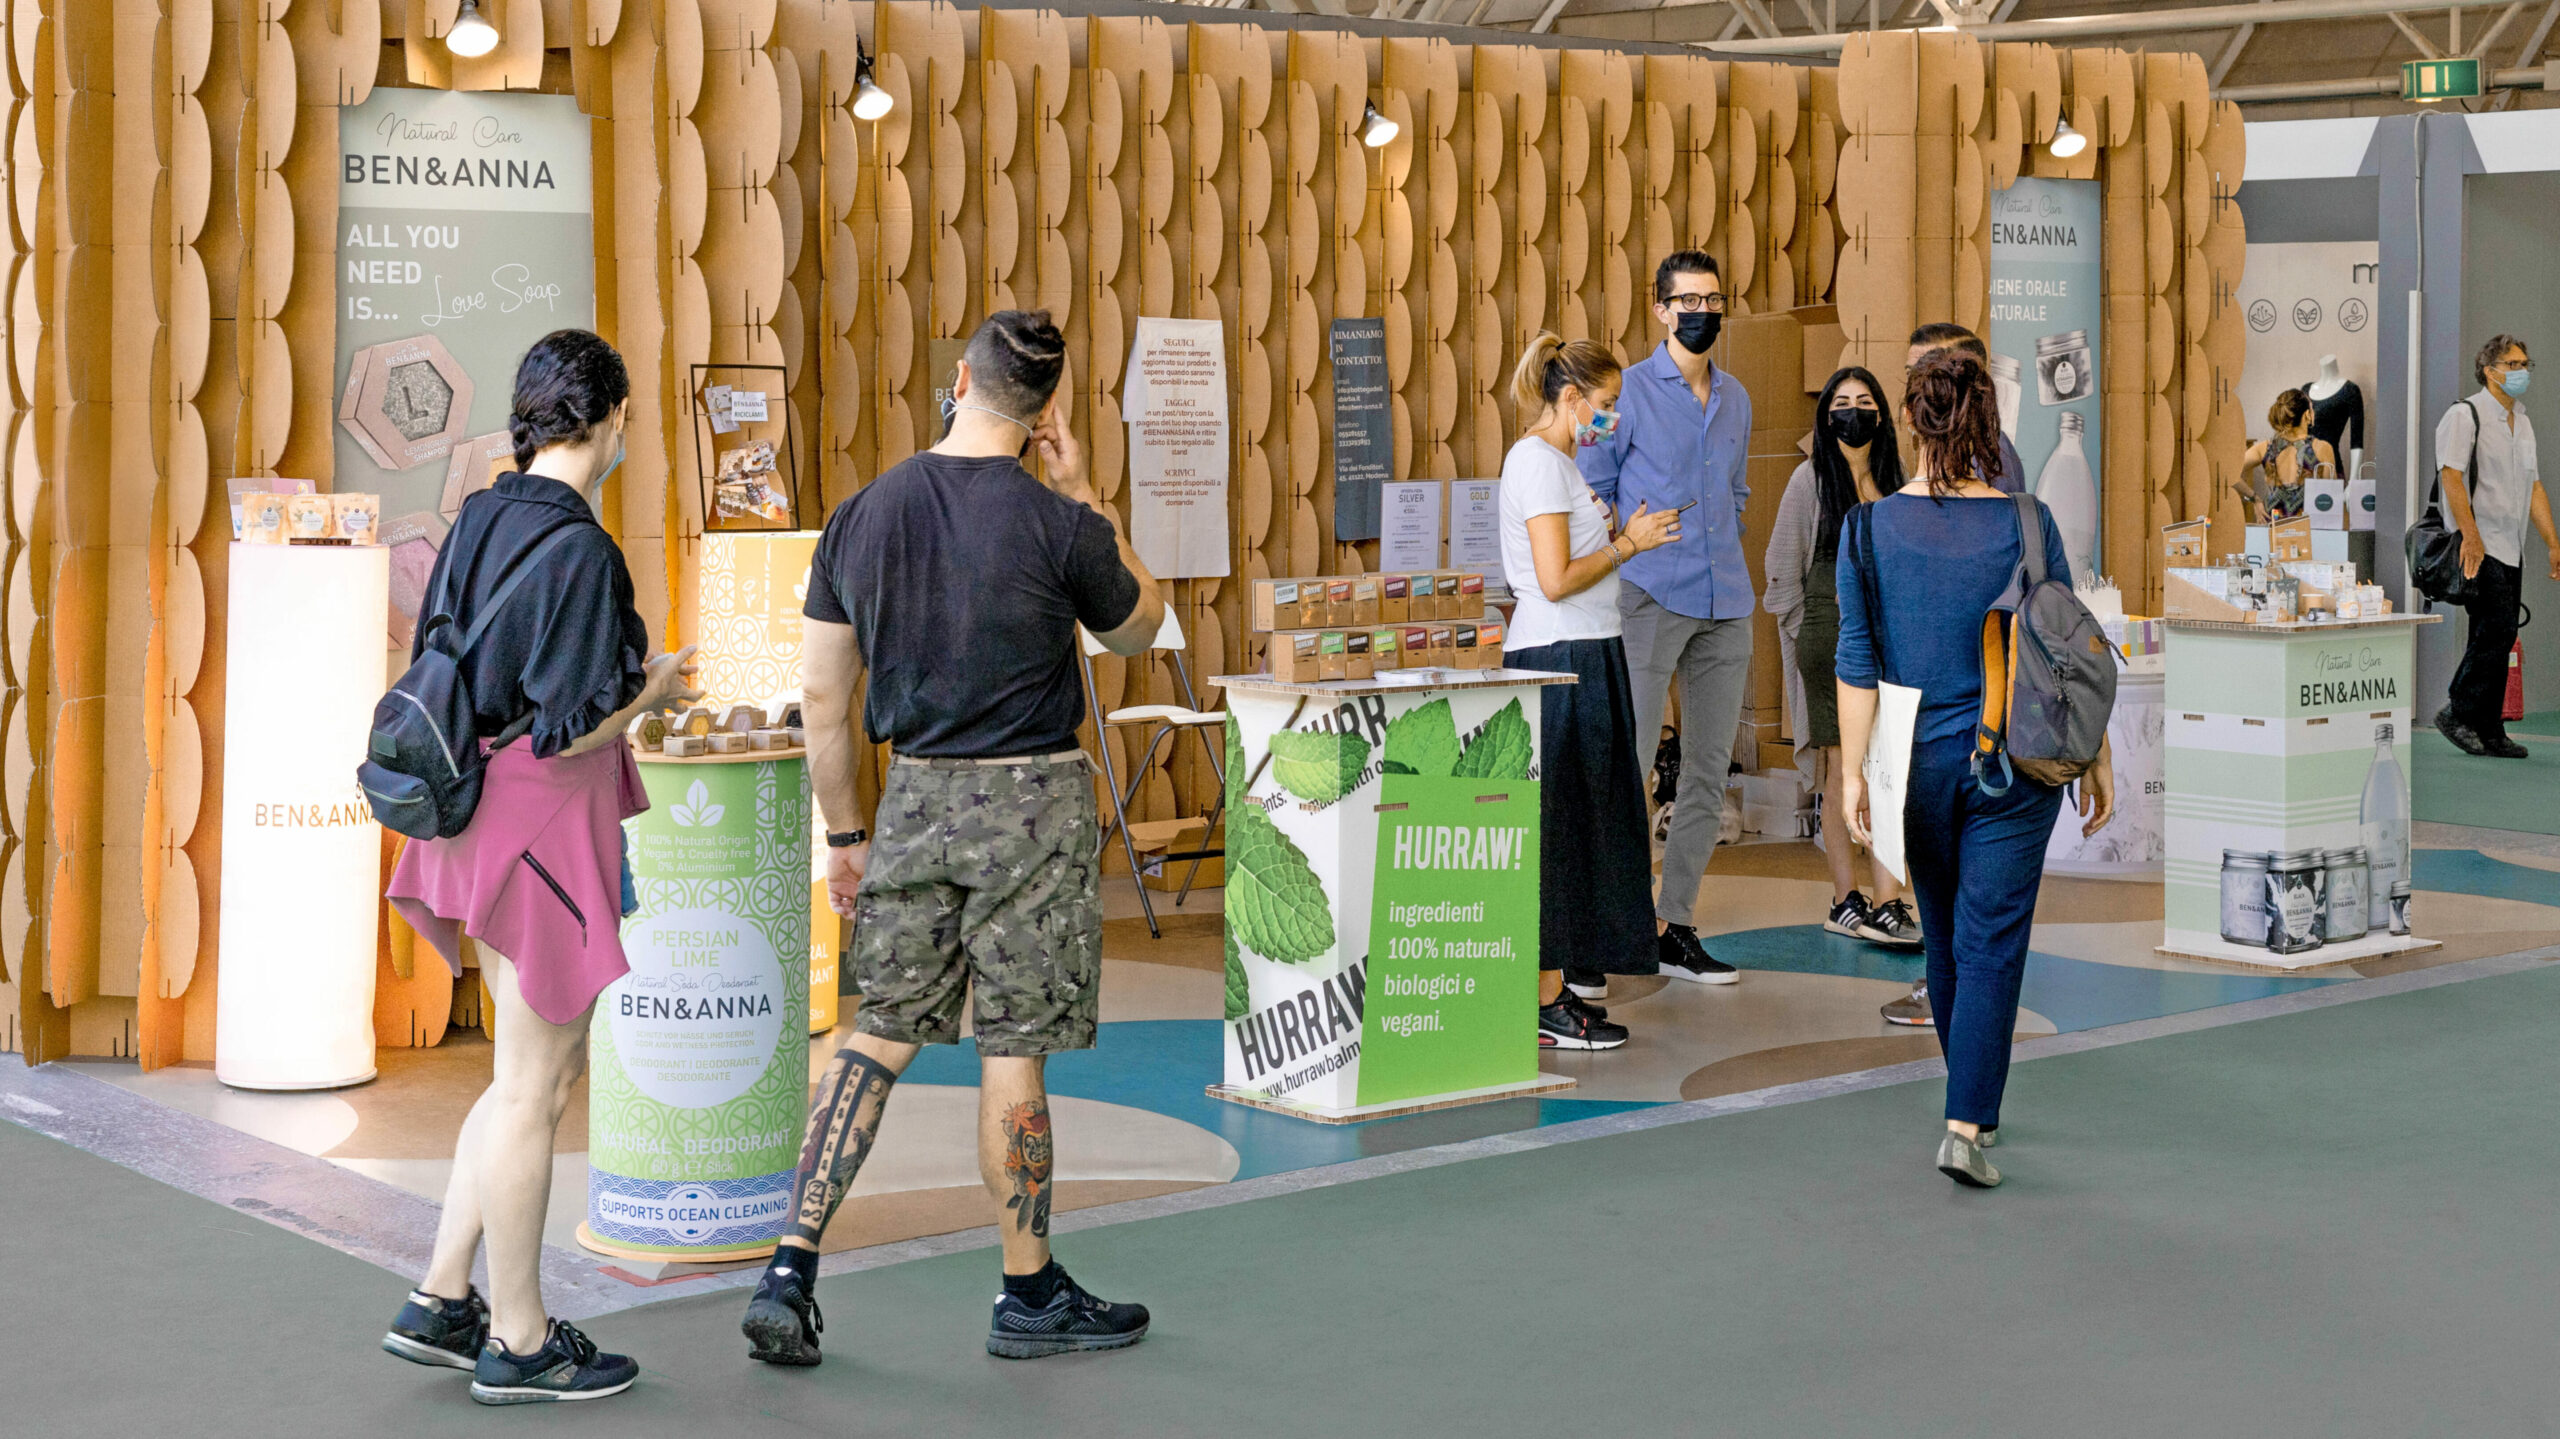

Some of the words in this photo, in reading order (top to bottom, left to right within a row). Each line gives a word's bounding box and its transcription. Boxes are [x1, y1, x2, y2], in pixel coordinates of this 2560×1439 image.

[377, 112, 458, 147] Natural
[472, 116, 522, 147] Care
[344, 154, 556, 189] BEN&ANNA
[346, 224, 399, 247] ALL
[406, 225, 460, 248] YOU
[347, 261, 422, 283] NEED
[421, 275, 487, 326] Love
[491, 263, 561, 312] Soap
[2026, 280, 2066, 297] ORALE
[348, 297, 399, 320] IS...
[1398, 494, 1425, 503] SILVER
[1470, 491, 1490, 501] GOLD
[2301, 677, 2397, 707] BEN&ANNA
[646, 834, 672, 845] 100%
[675, 835, 716, 846] Natural
[718, 835, 750, 848] Origin
[643, 848, 674, 860] Vegan
[677, 849, 686, 859] &
[730, 848, 751, 858] free
[657, 862, 674, 872] 0%
[676, 863, 736, 872] Aluminium
[1389, 901, 1484, 928] ingredienti
[653, 930, 739, 947] PERSIAN
[1388, 938, 1439, 959] 100%
[1444, 937, 1516, 961] naturali,
[671, 950, 720, 967] LIME
[671, 973, 699, 992] Soda
[1384, 974, 1460, 1000] biologici
[1465, 978, 1476, 994] e
[621, 994, 772, 1020] BEN&ANNA
[1381, 1010, 1445, 1037] vegani.
[695, 1056, 761, 1069] DEODORANTE
[657, 1071, 732, 1082] DESODORANTE
[600, 1134, 673, 1155] NATURAL
[684, 1128, 791, 1156] DEODORANT
[706, 1159, 734, 1174] Stick
[602, 1198, 664, 1221] SUPPORTS
[668, 1207, 720, 1221] OCEAN
[724, 1197, 788, 1219] CLEANING
